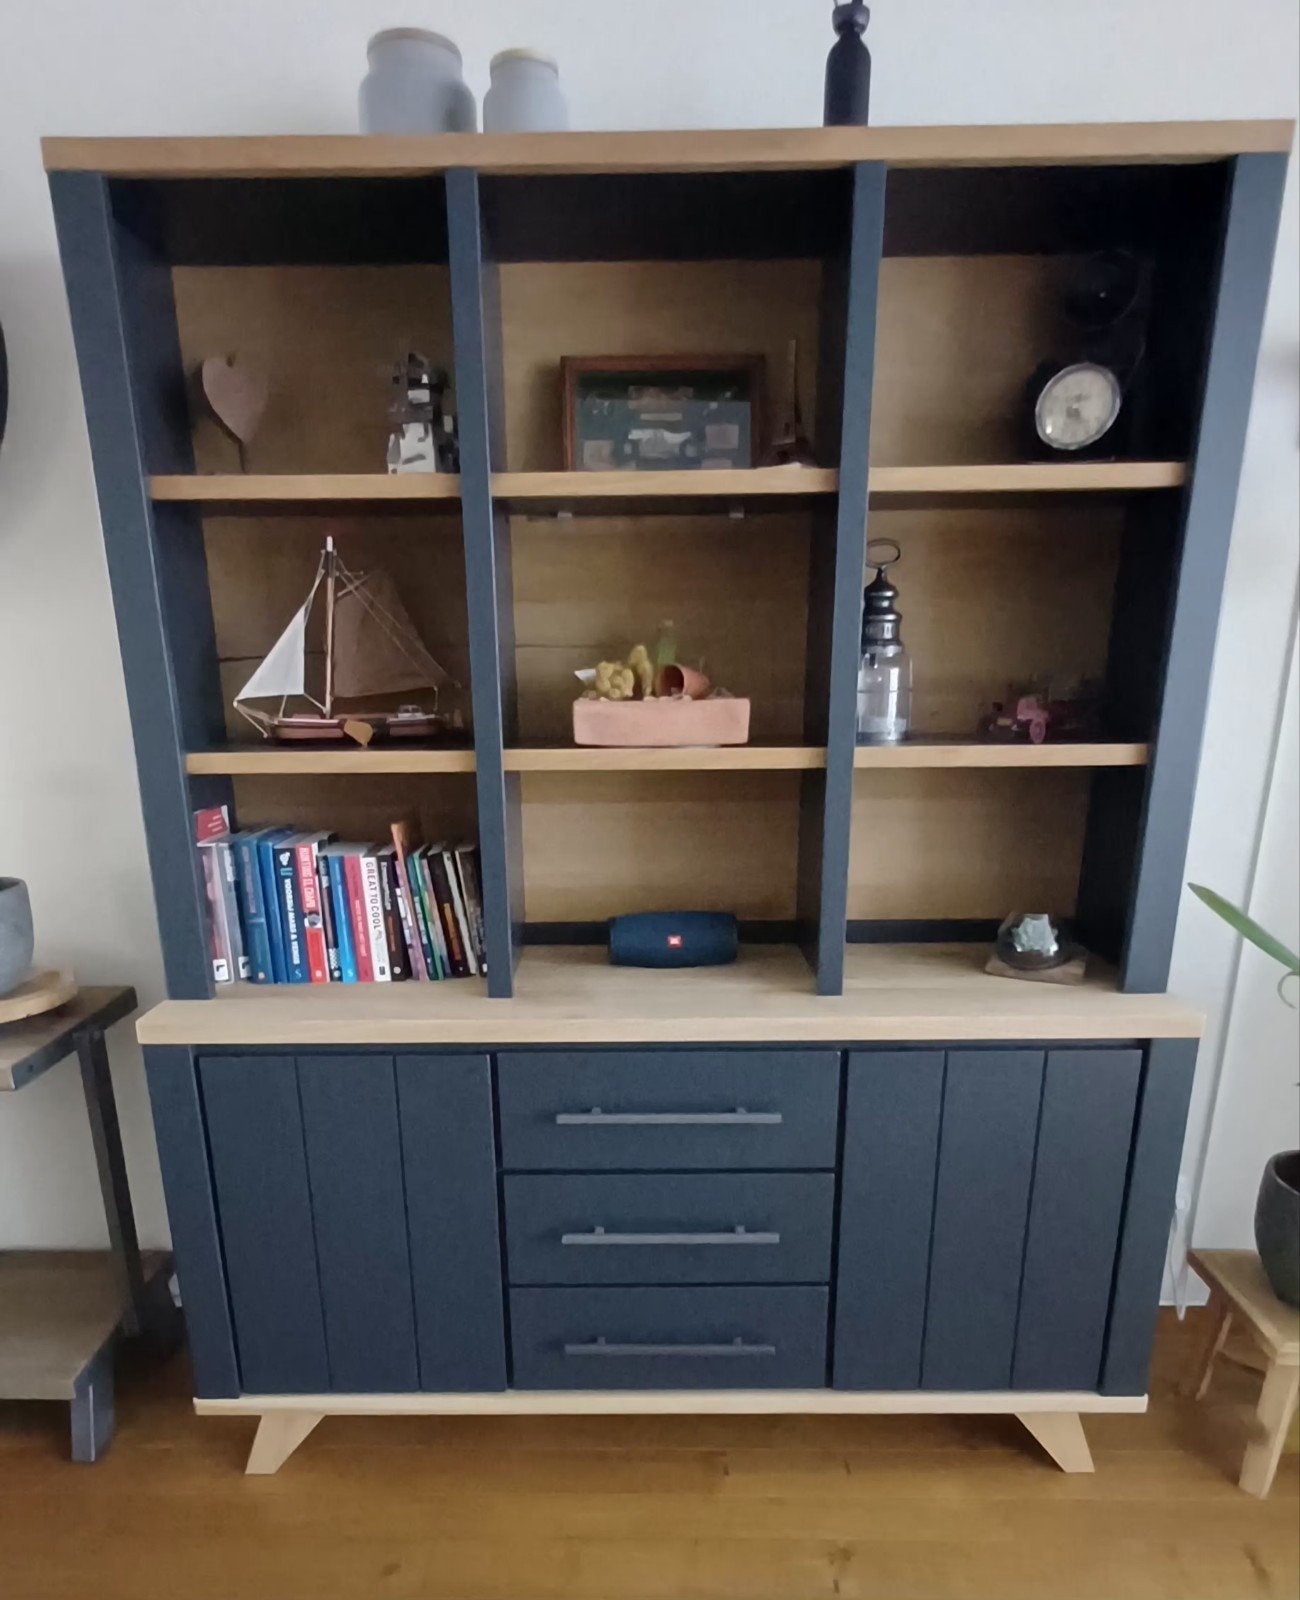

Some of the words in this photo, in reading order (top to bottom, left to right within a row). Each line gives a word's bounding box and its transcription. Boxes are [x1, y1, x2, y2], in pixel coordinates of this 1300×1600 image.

[365, 861, 377, 891] GREAT
[369, 893, 379, 903] TO
[371, 905, 382, 930] COOL
